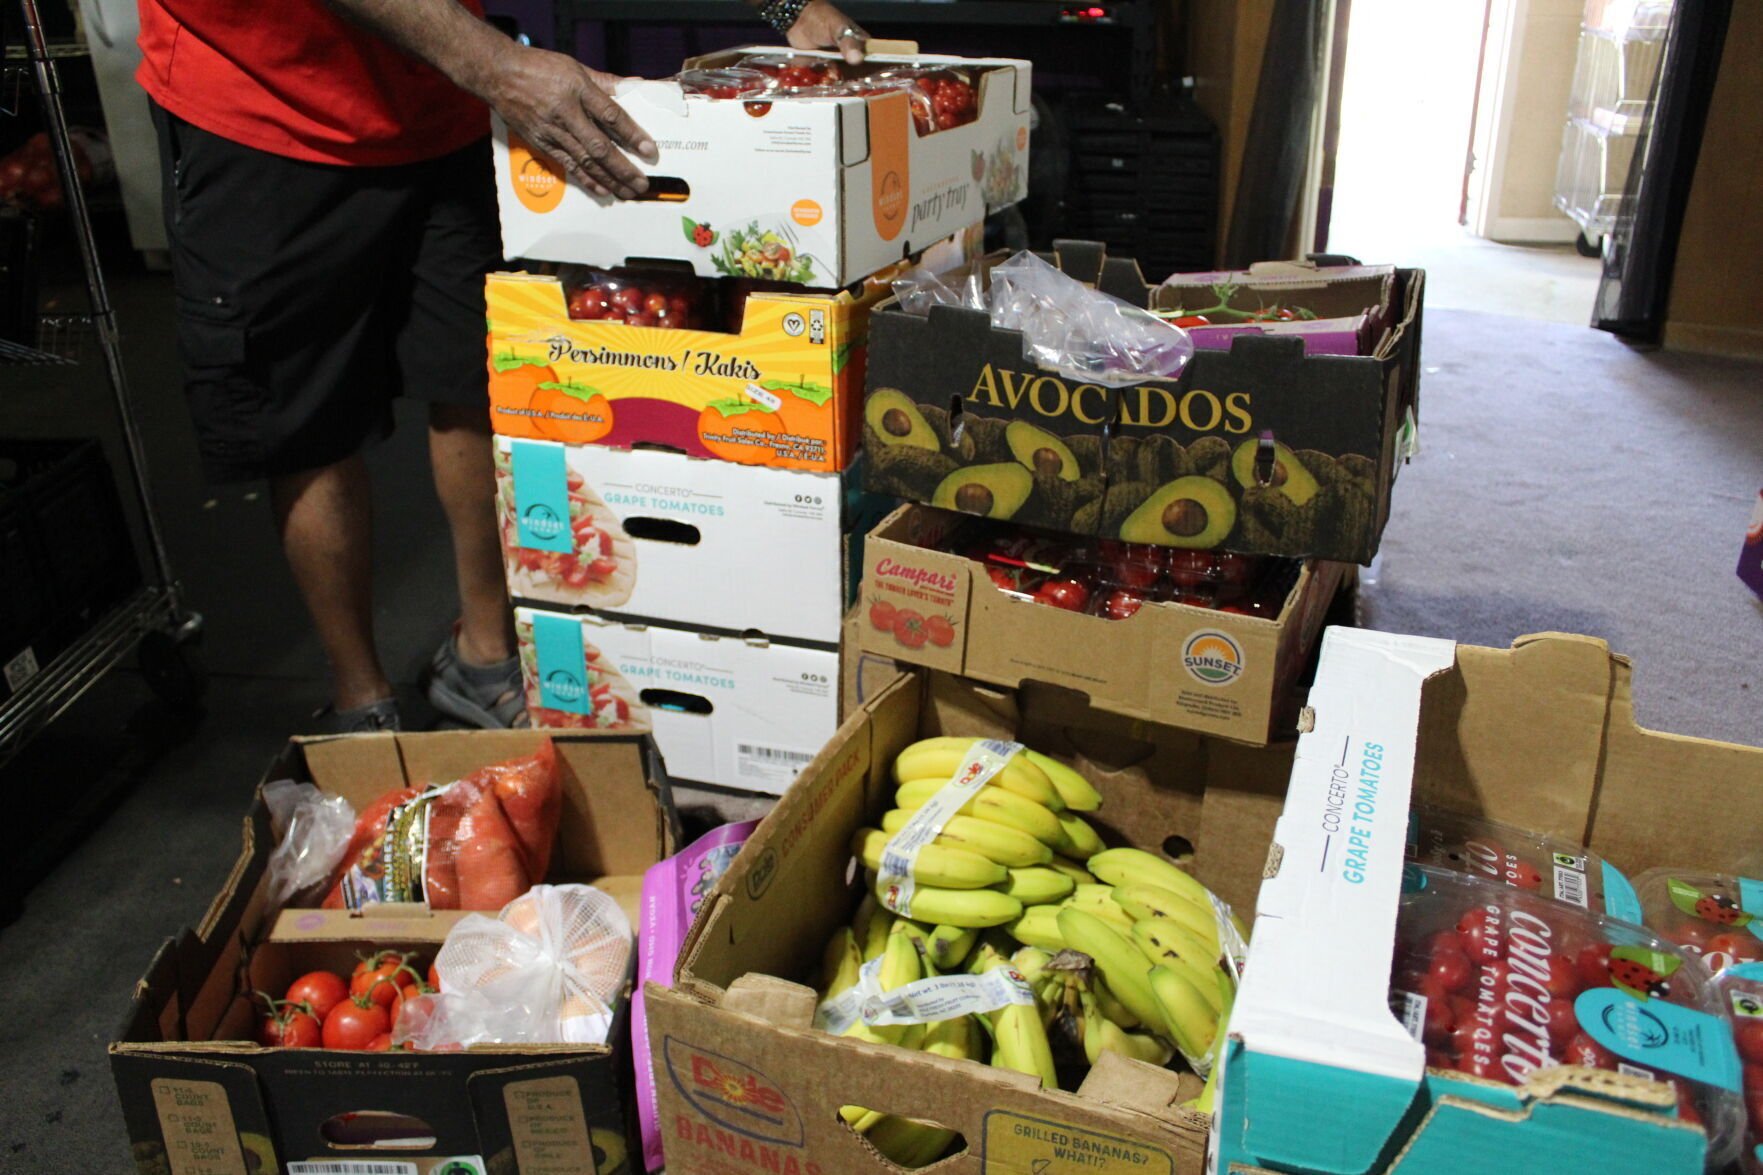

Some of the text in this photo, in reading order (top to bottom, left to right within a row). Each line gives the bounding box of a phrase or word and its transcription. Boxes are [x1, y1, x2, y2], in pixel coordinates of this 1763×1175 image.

[548, 339, 677, 371] Persimmons
[694, 351, 761, 380] Kakis
[603, 492, 725, 516] GRAPE TOMATOES
[634, 483, 691, 498] CONCERTO
[876, 557, 957, 591] Campari
[620, 664, 735, 689] GRAPE TOMATOES
[649, 656, 704, 671] CONCERTO
[1184, 657, 1242, 676] SUNSET
[1322, 764, 1349, 833] CONCERTO
[1342, 741, 1384, 885] GRAPE TOMATOES
[1472, 905, 1500, 1066] GRAPE TOMATOES
[1501, 910, 1560, 1085] concerto
[691, 1054, 785, 1113] Dole
[675, 1114, 822, 1175] BANANAS
[1014, 1123, 1149, 1166] GRILLED BANANAS?
